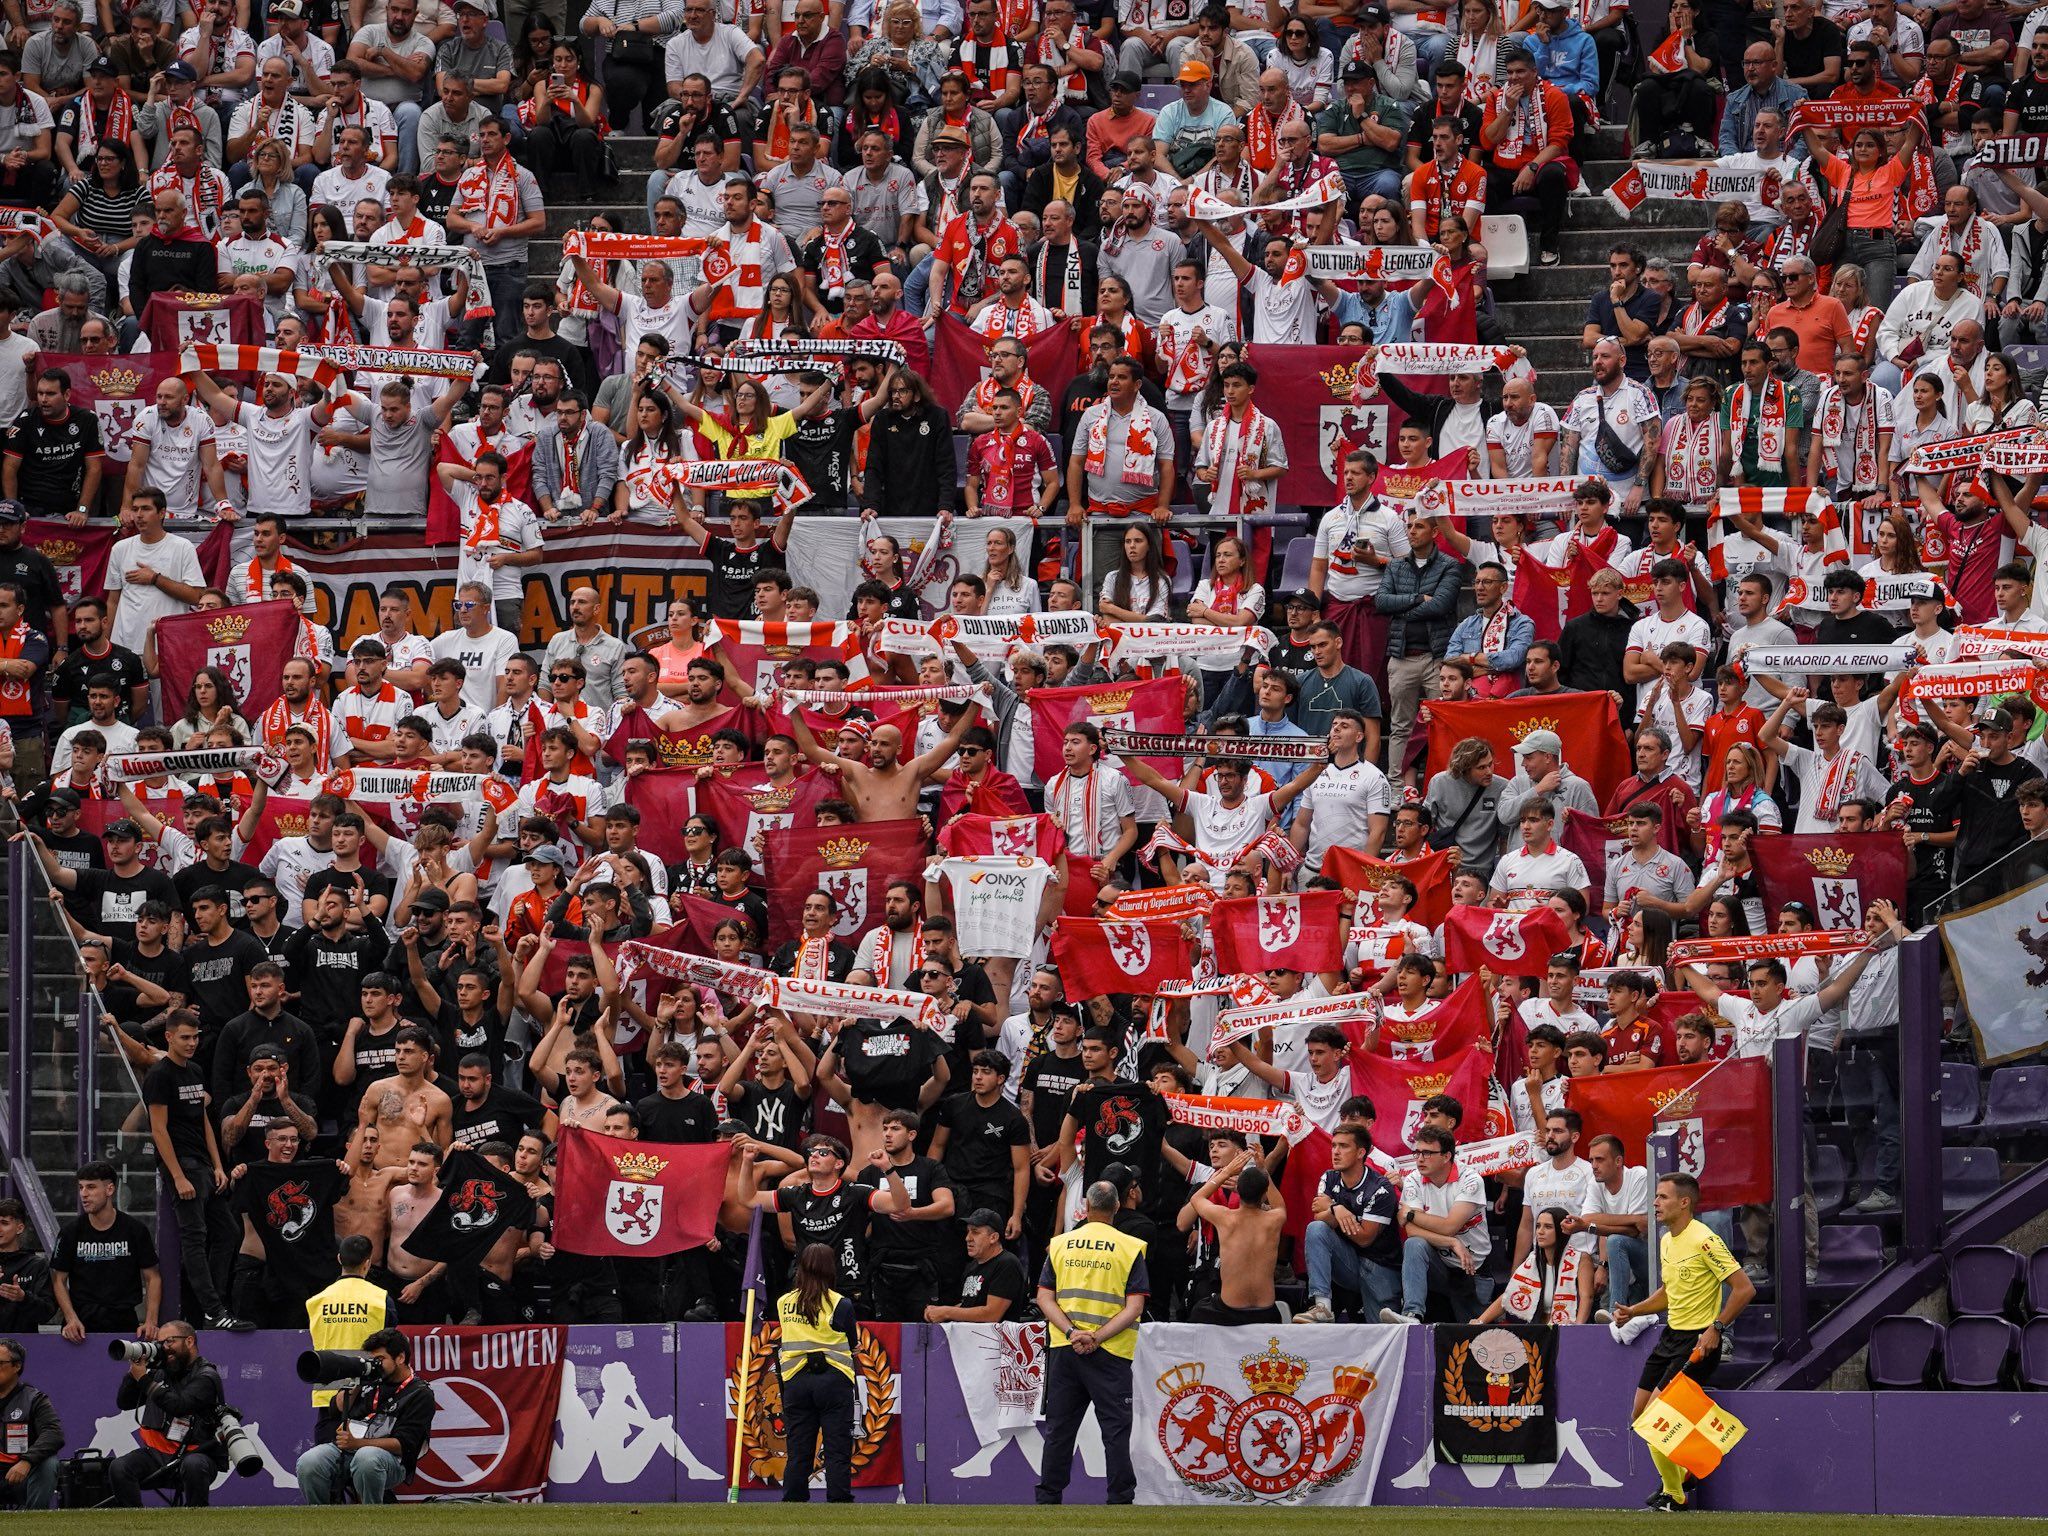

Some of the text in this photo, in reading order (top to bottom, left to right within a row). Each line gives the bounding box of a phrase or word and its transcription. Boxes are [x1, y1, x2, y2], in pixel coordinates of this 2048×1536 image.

[1810, 102, 1911, 113] CULTURAL Y DEPORTIVA
[2022, 105, 2048, 114] ASPI
[1824, 112, 1897, 123] LEONESA
[1641, 172, 1755, 193] CULTURAL LEONESA
[687, 205, 727, 219] SPIRE
[151, 249, 193, 259] DOCKERS
[1312, 252, 1433, 271] CULTURAL LEONESA
[1380, 344, 1488, 359] CULTURAL
[374, 350, 476, 375] RAMPANTE
[35, 440, 81, 454] ASPIRE
[157, 444, 196, 454] ASPIRE
[42, 452, 75, 461] ACADEMY
[1460, 481, 1577, 498] CULTURAL
[963, 617, 1089, 636] CULTURAL LEONESA
[1120, 625, 1238, 638] ULTURAL
[459, 651, 484, 667] HH
[1765, 653, 1889, 666] DE MADRID AL REINO
[1913, 676, 2027, 698] ORGULLO DE LEÓN
[1127, 734, 1306, 758] ORGULLO CAZURRO
[360, 773, 476, 795] CULTURAL LEONESA
[1313, 782, 1357, 791] ASPIRE
[1206, 820, 1246, 833] ASPIRE
[985, 873, 1027, 889] ONYX
[1736, 941, 1808, 956] LEONESA
[785, 979, 915, 1009] CULTURAL
[1231, 1000, 1357, 1029] CULTURAL LEONESA
[800, 1212, 844, 1227] ASPIRE
[843, 1237, 856, 1266] MGS
[1066, 1239, 1116, 1252] EULEN
[1065, 1258, 1112, 1271] SEGURIDAD
[322, 1303, 368, 1316] EULEN
[323, 1316, 368, 1324] SEGURIDAD
[412, 1327, 558, 1372] IÓN JOVEN
[1322, 1396, 1360, 1409] CULTUR
[1227, 1398, 1263, 1454] CULTURAL
[1278, 1398, 1313, 1457] DEPORTIVA
[1232, 1460, 1309, 1491] LEONESA
